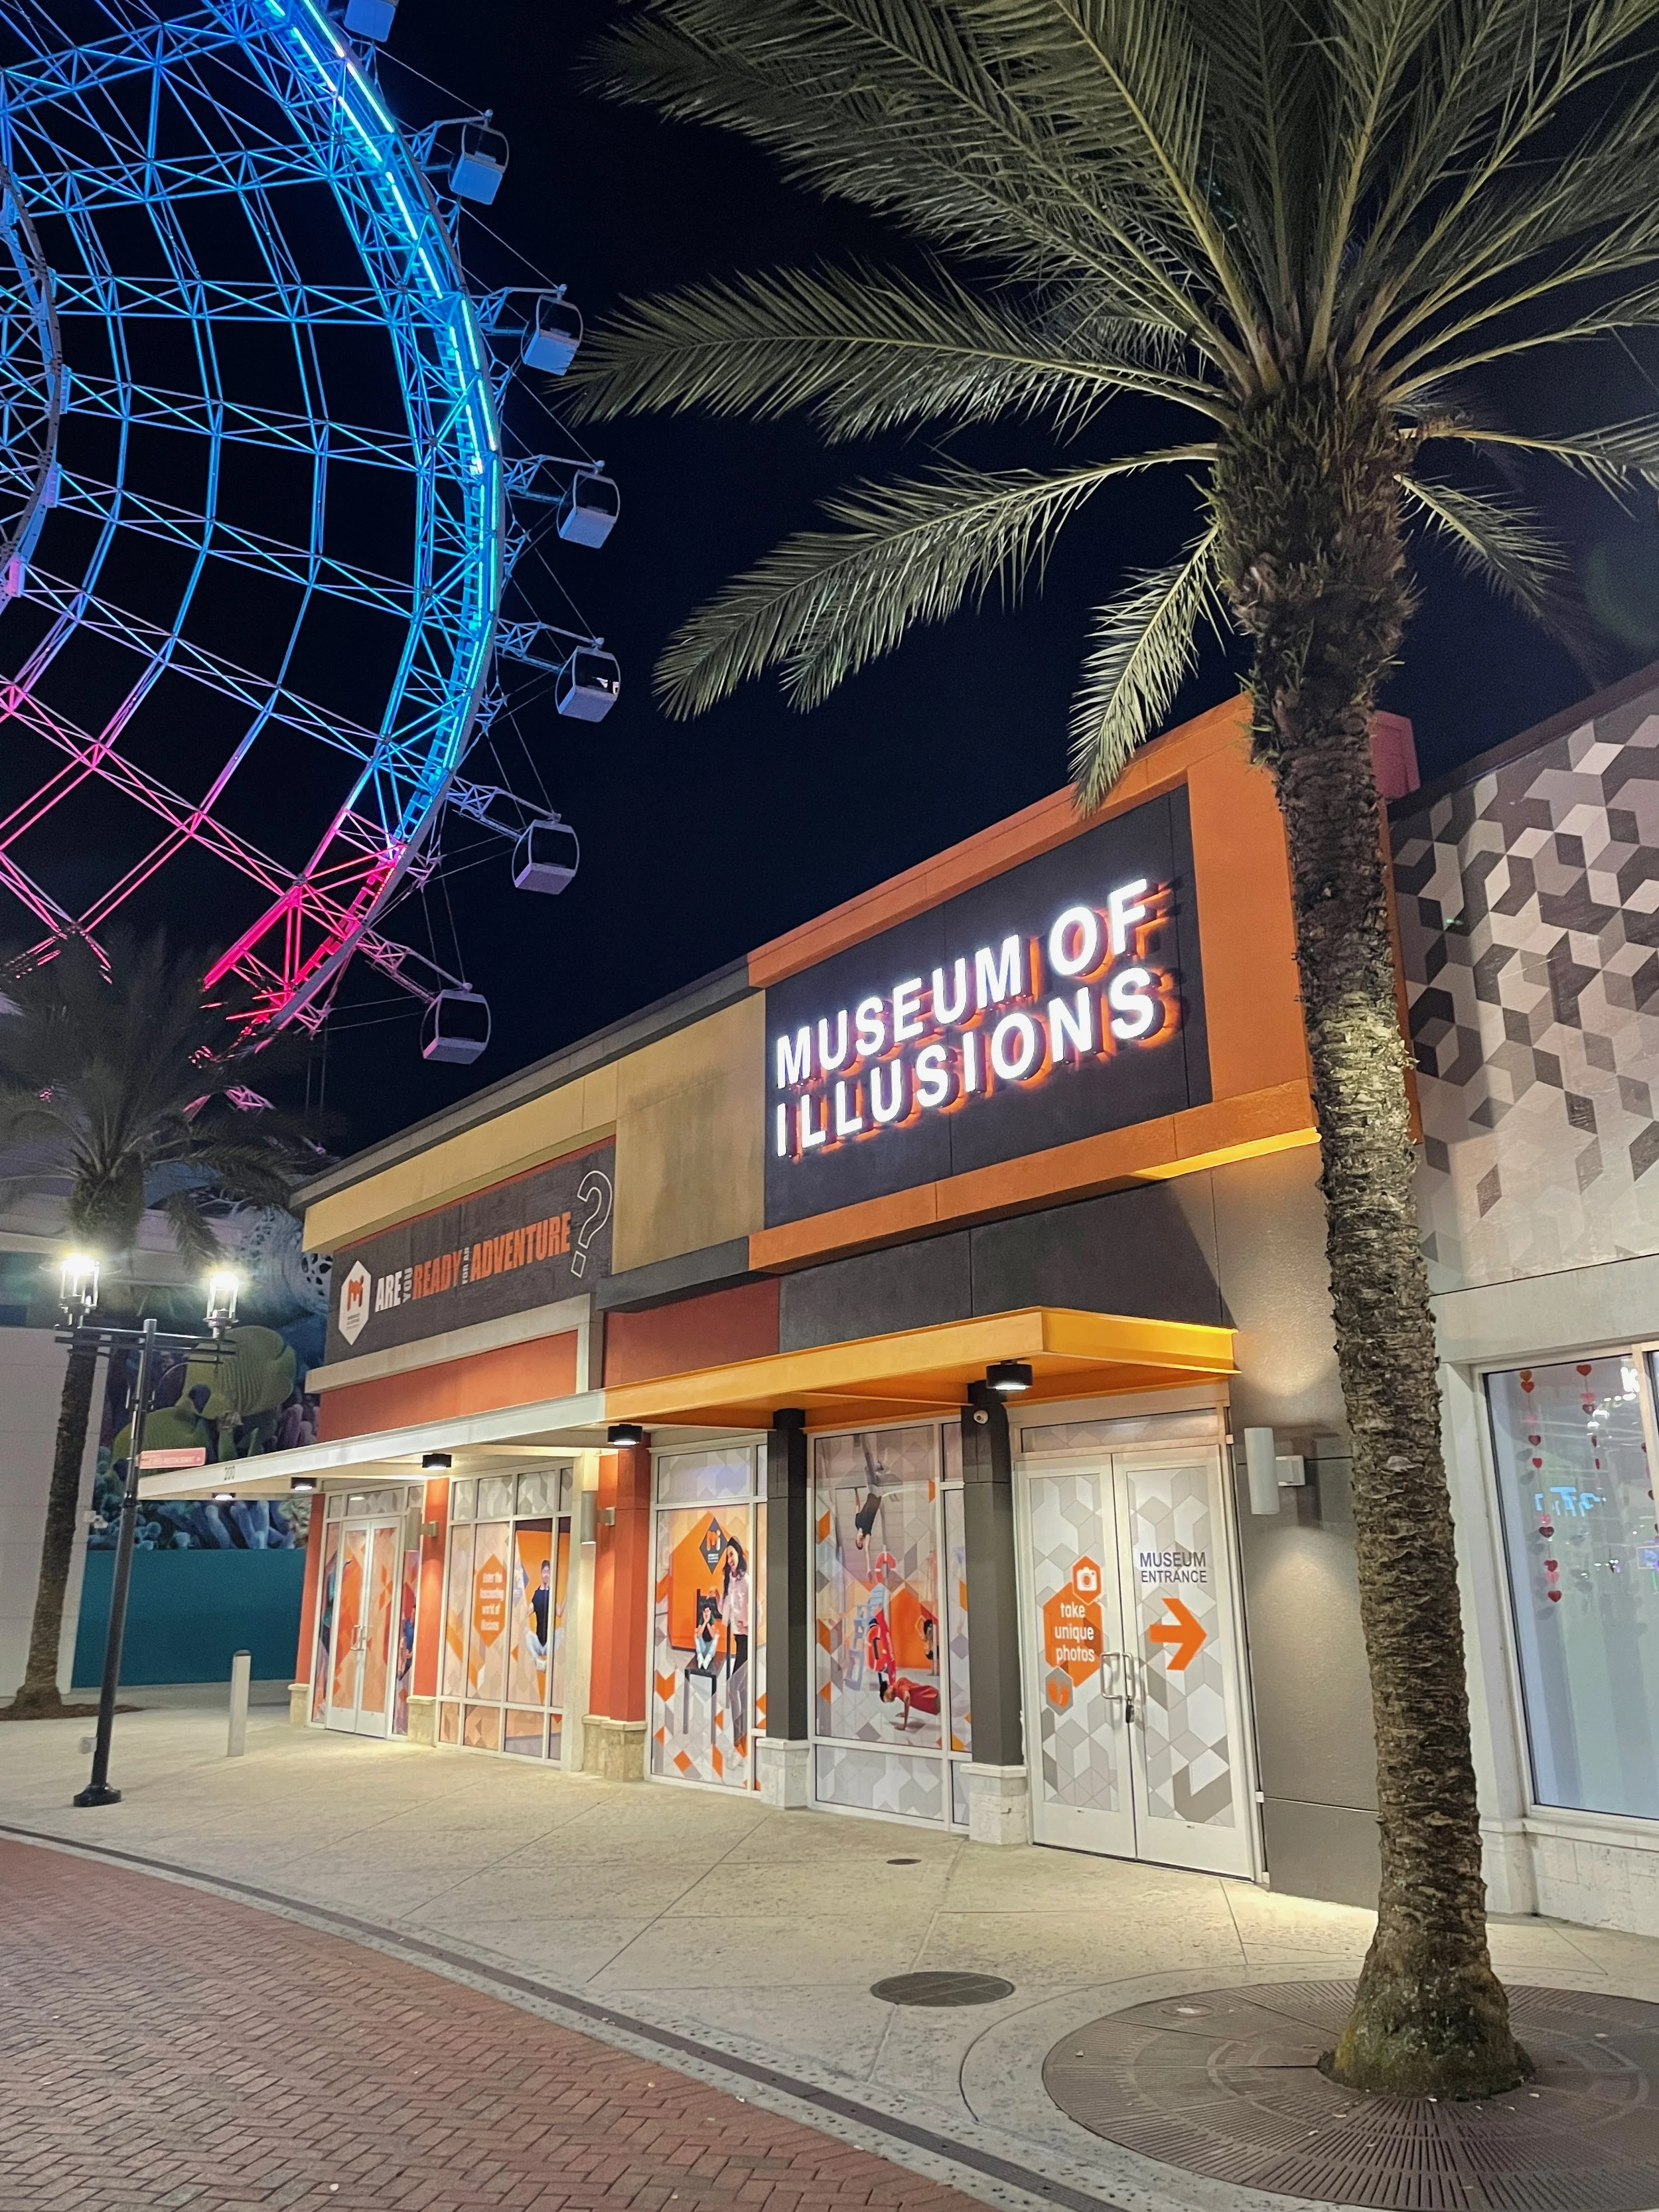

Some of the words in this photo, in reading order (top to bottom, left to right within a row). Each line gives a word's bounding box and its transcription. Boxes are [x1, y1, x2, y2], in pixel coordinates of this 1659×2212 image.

[776, 934, 1023, 1090] MUSEUM
[1048, 877, 1149, 976] OF
[776, 967, 1155, 1157] ILLUSIONS
[375, 1271, 402, 1312] ARE
[403, 1268, 413, 1303] YOU
[412, 1249, 463, 1300] READY
[469, 1211, 571, 1282] ADVENTURE
[1139, 1552, 1206, 1567] MUSEUM
[1141, 1570, 1208, 1584] ENTRANCE
[1060, 1601, 1086, 1618] take
[1054, 1623, 1094, 1643] unique
[1056, 1644, 1095, 1664] photos
